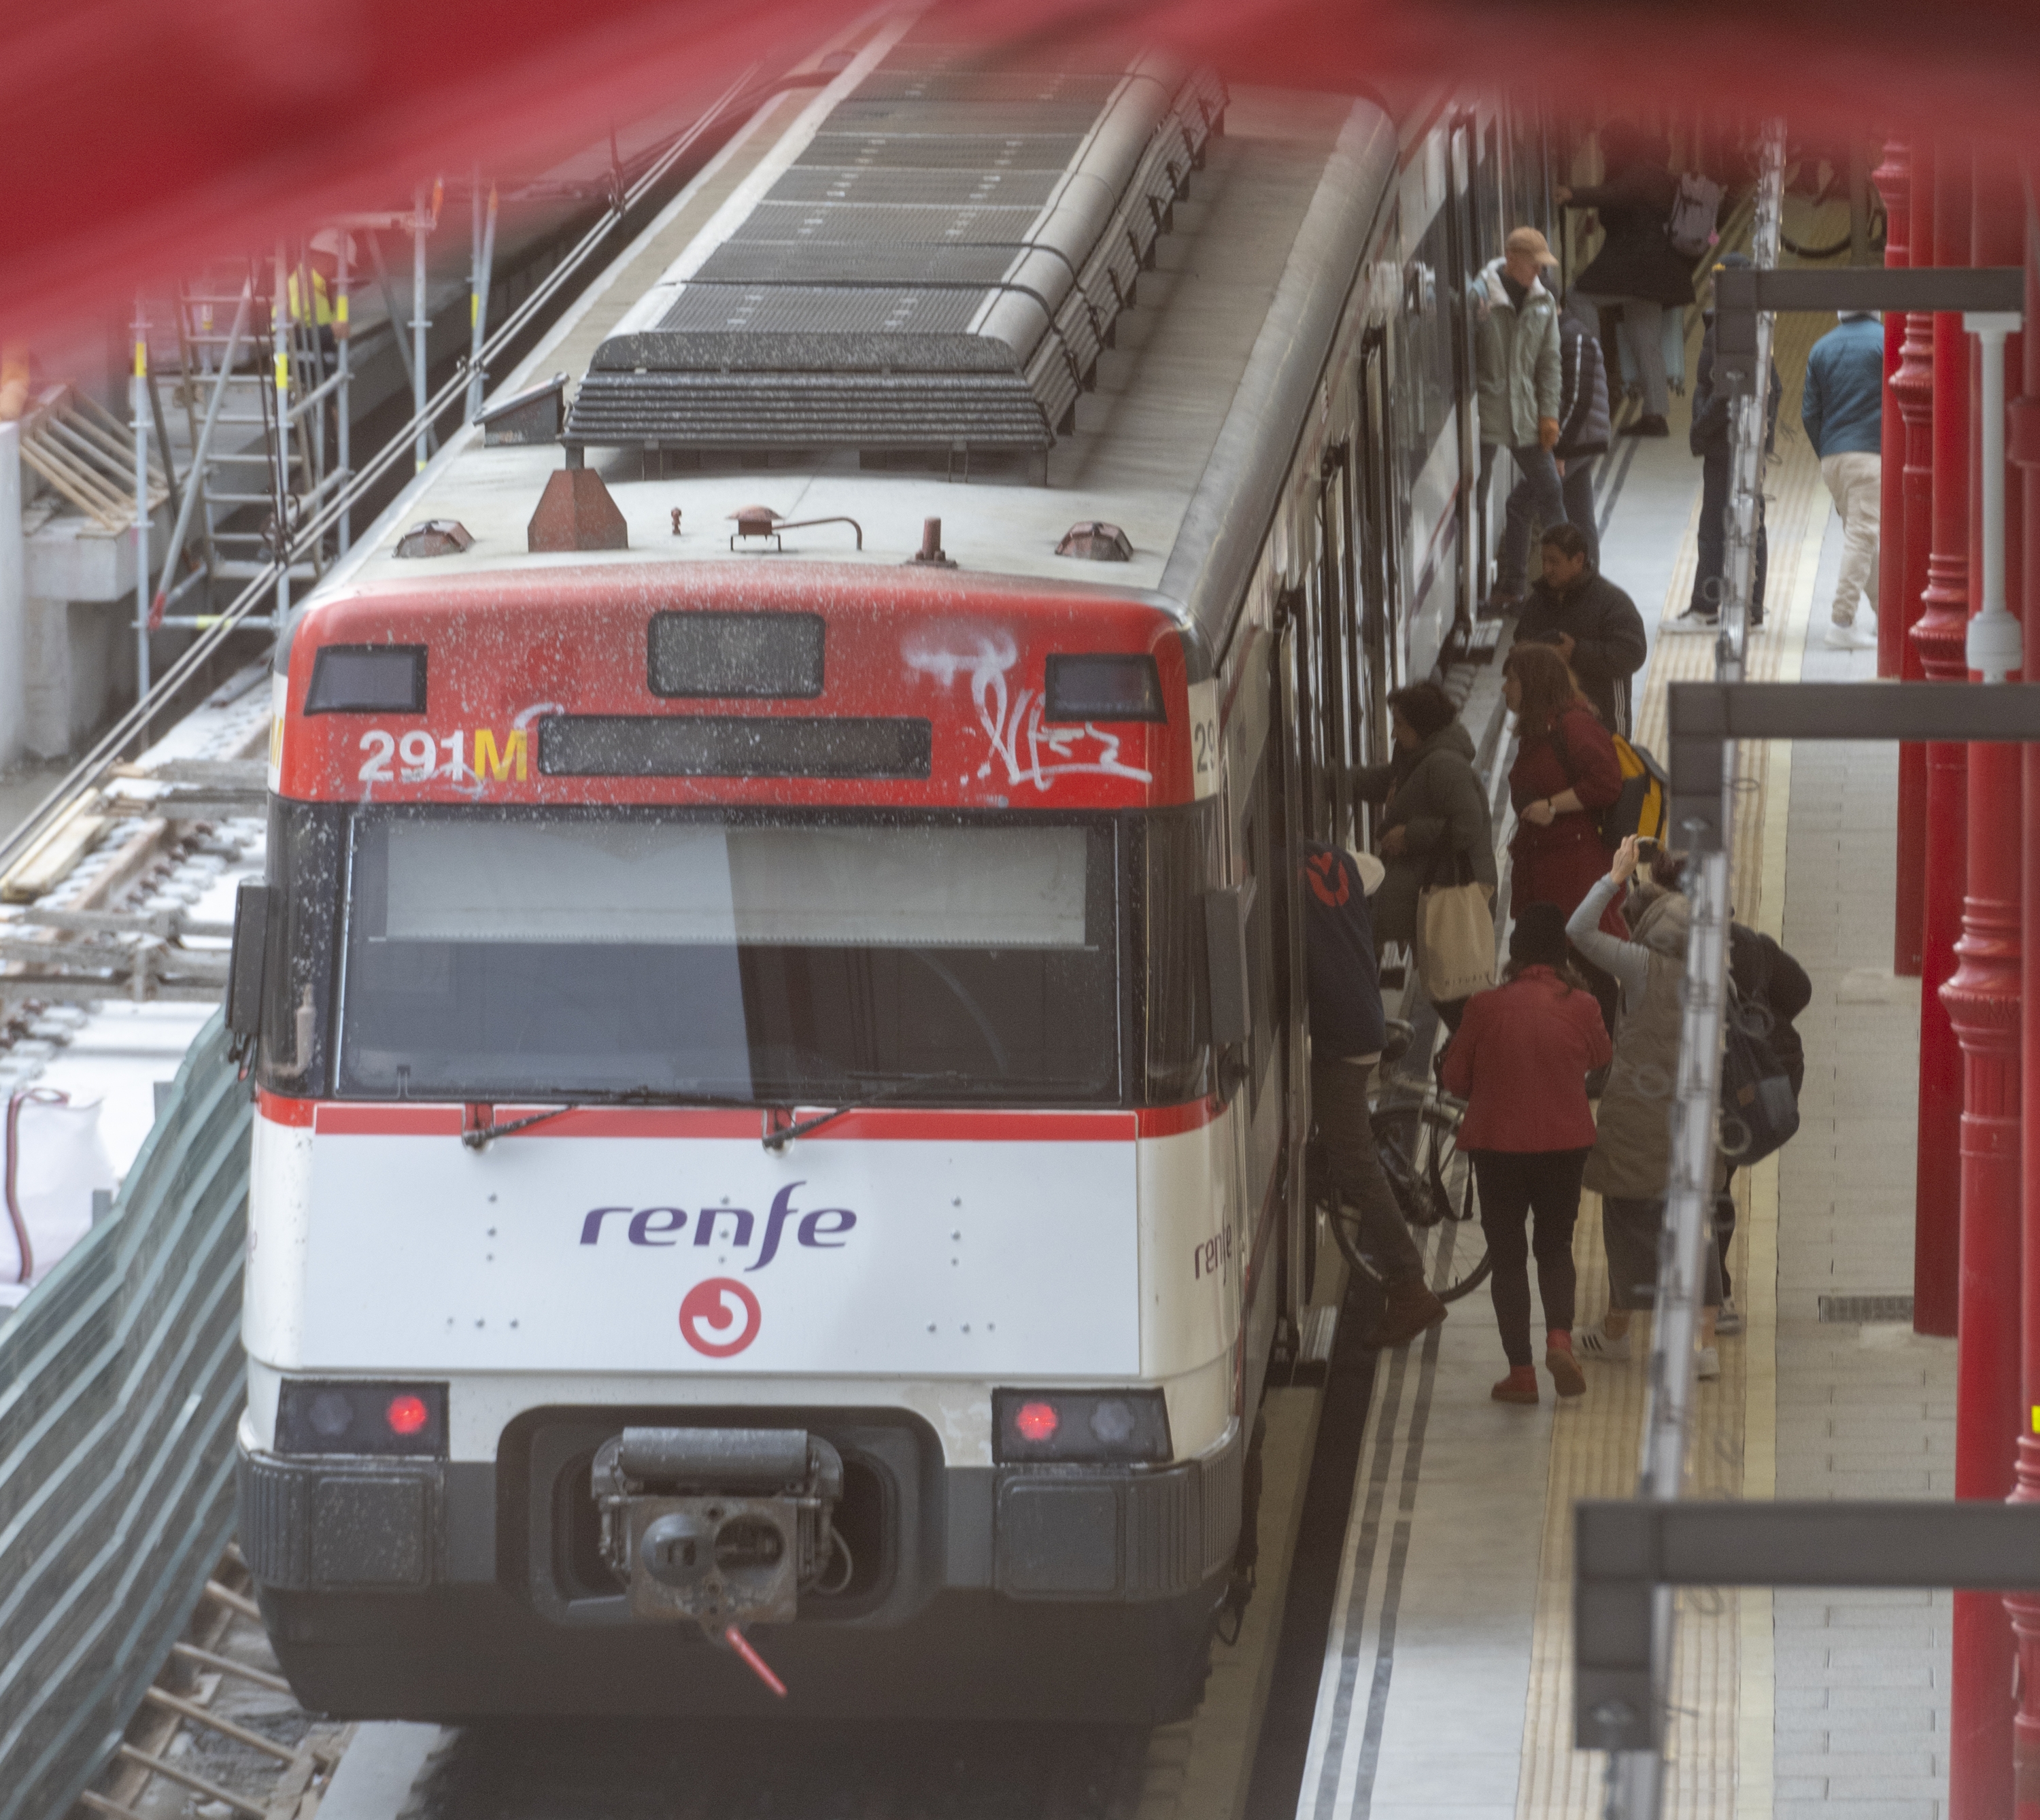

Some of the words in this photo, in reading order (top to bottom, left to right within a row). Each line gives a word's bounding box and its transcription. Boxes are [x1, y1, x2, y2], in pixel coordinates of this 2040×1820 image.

[358, 729, 528, 783] 291M
[579, 1180, 857, 1273] renfe
[1194, 1204, 1231, 1287] renfe
